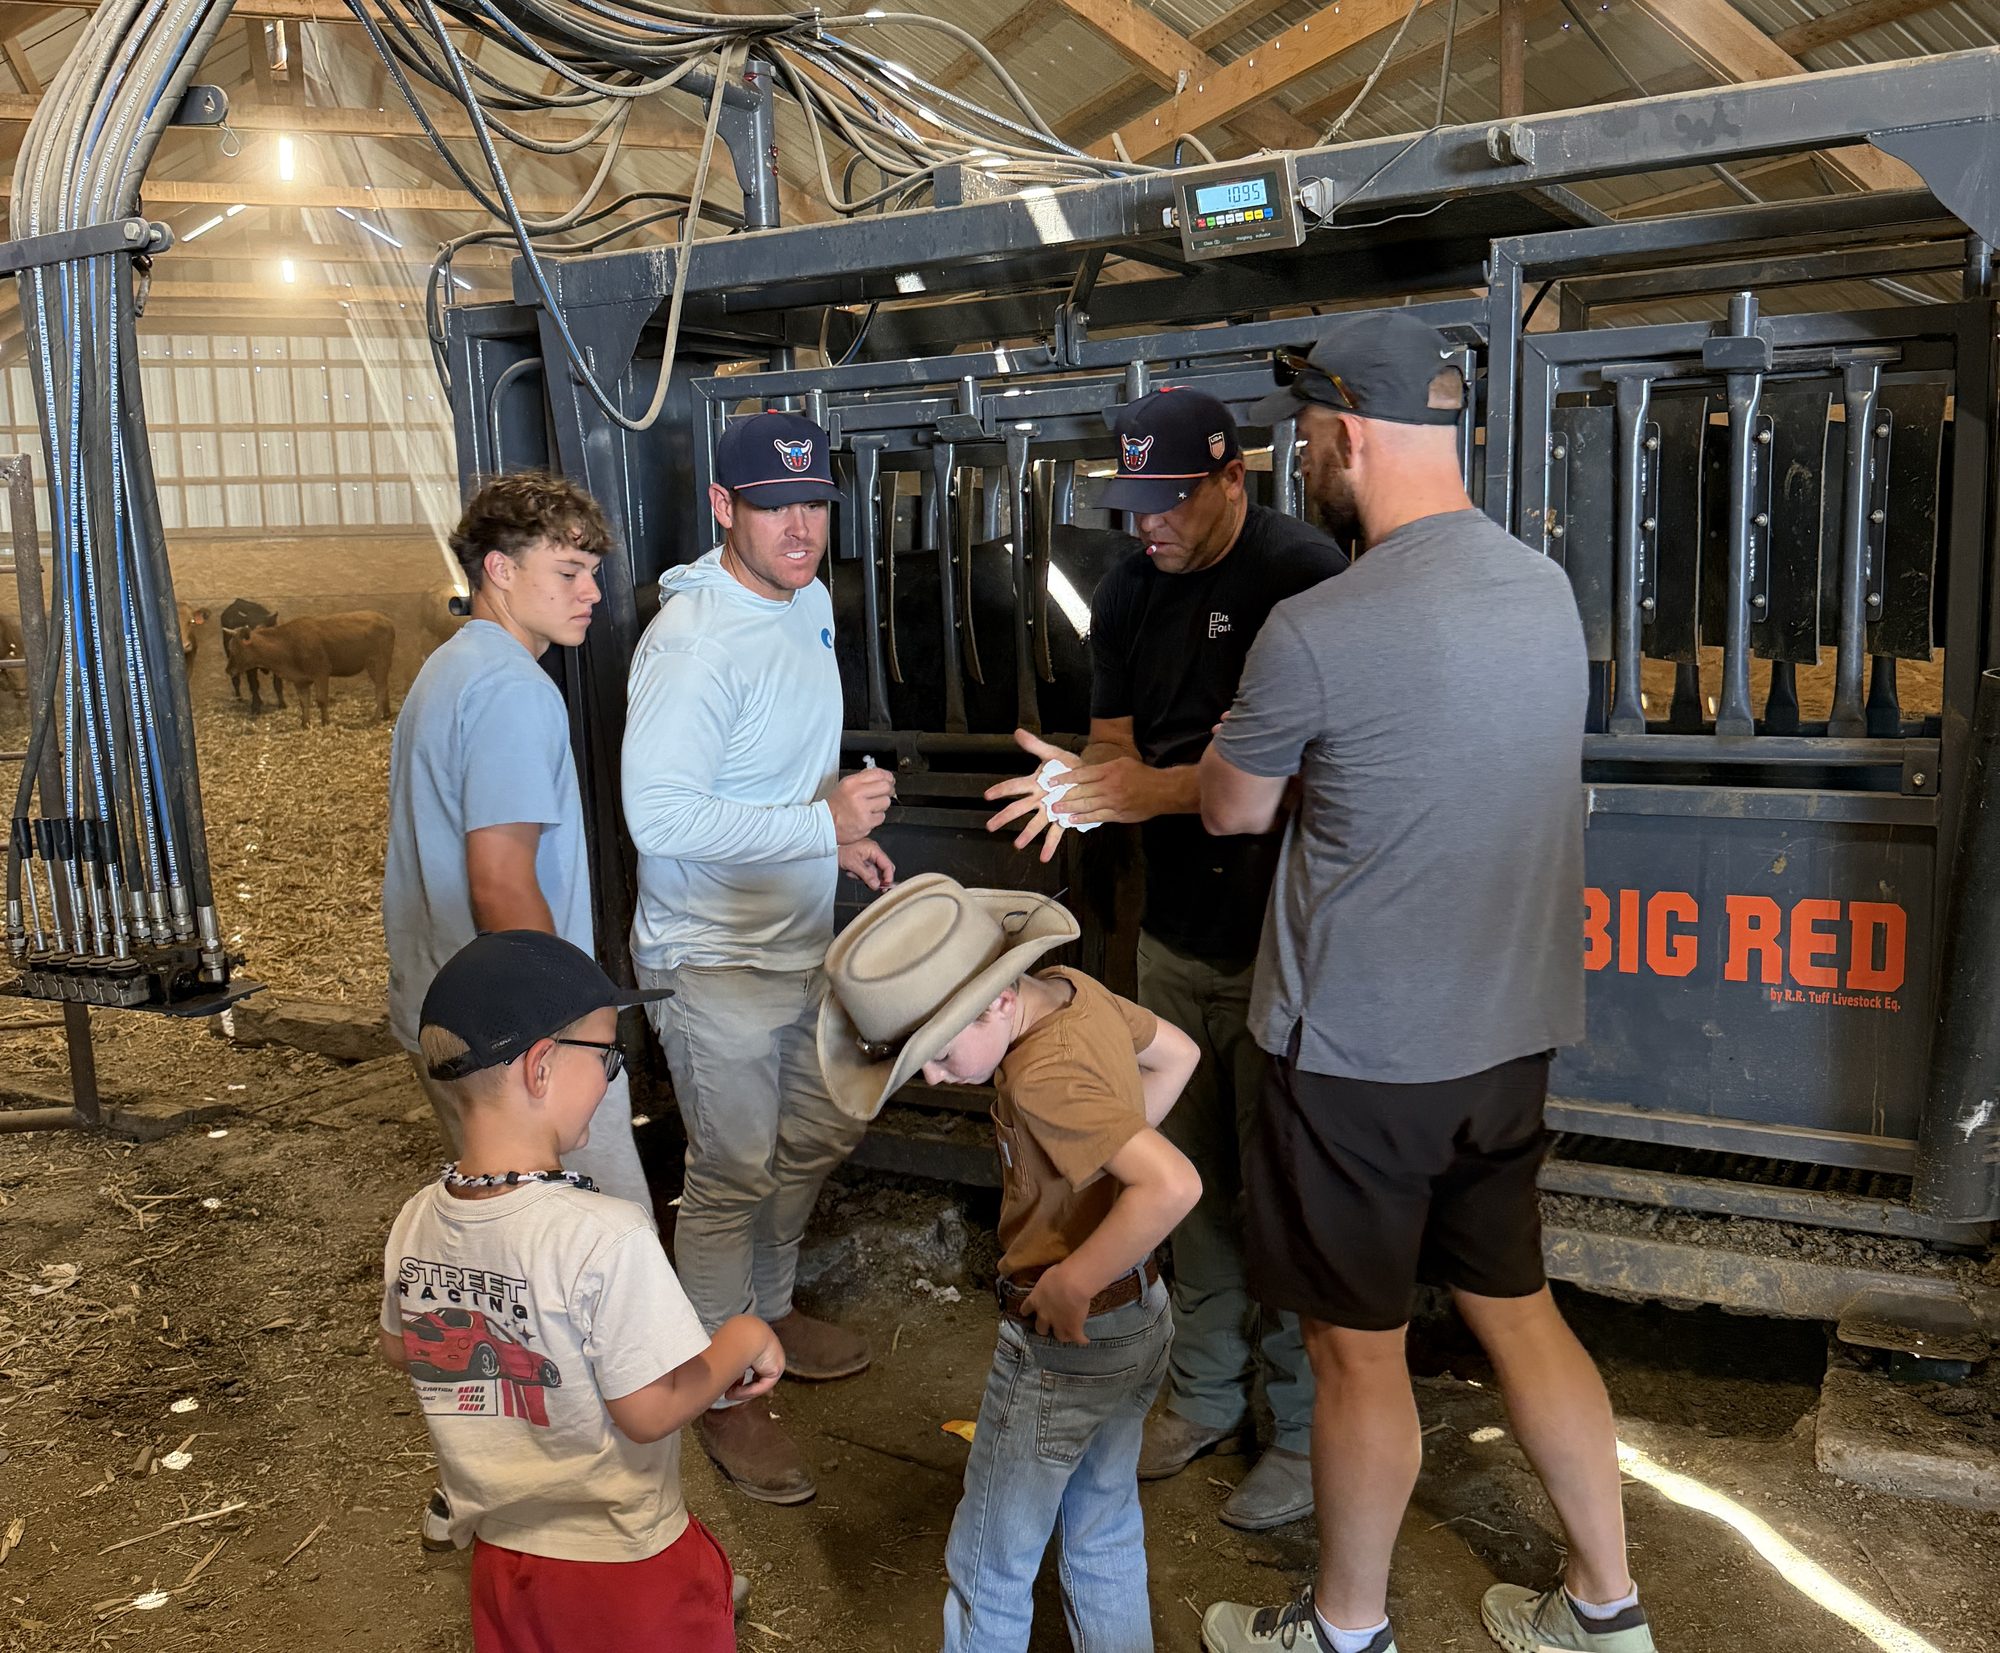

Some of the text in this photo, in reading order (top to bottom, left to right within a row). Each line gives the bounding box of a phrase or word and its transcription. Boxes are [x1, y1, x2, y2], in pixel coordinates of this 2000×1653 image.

[107, 123, 124, 153] GERMAN
[74, 156, 90, 208] TECHNOLOGY
[93, 152, 113, 204] TECHNOLOGY
[1227, 183, 1260, 203] 1095
[71, 388, 79, 407] R1AT
[71, 409, 79, 421] 100
[52, 456, 62, 486] SUMMIT
[71, 456, 78, 467] EN
[113, 462, 122, 517] TECHNOLOGY
[63, 598, 72, 650] TECHNOLOGY
[125, 634, 134, 664] SUMMIT
[133, 639, 145, 674] GERMAN
[128, 667, 136, 682] 1SN
[79, 666, 94, 719] TECHNOLOGY
[101, 696, 109, 709] DIN
[130, 683, 138, 702] DN10
[138, 674, 156, 728] TECHNOLOGY
[132, 704, 140, 718] DIN
[87, 720, 98, 754] GERMAN
[92, 754, 101, 775] WITH
[95, 774, 105, 797] MADE
[98, 797, 107, 810] PSI
[166, 841, 177, 871] SUMMIT
[1584, 887, 1907, 993] BIG RED
[1770, 987, 1901, 1013] by R.R. Tuff Livestock Eq.
[400, 1256, 527, 1303] STREET
[400, 1283, 528, 1320] RACING
